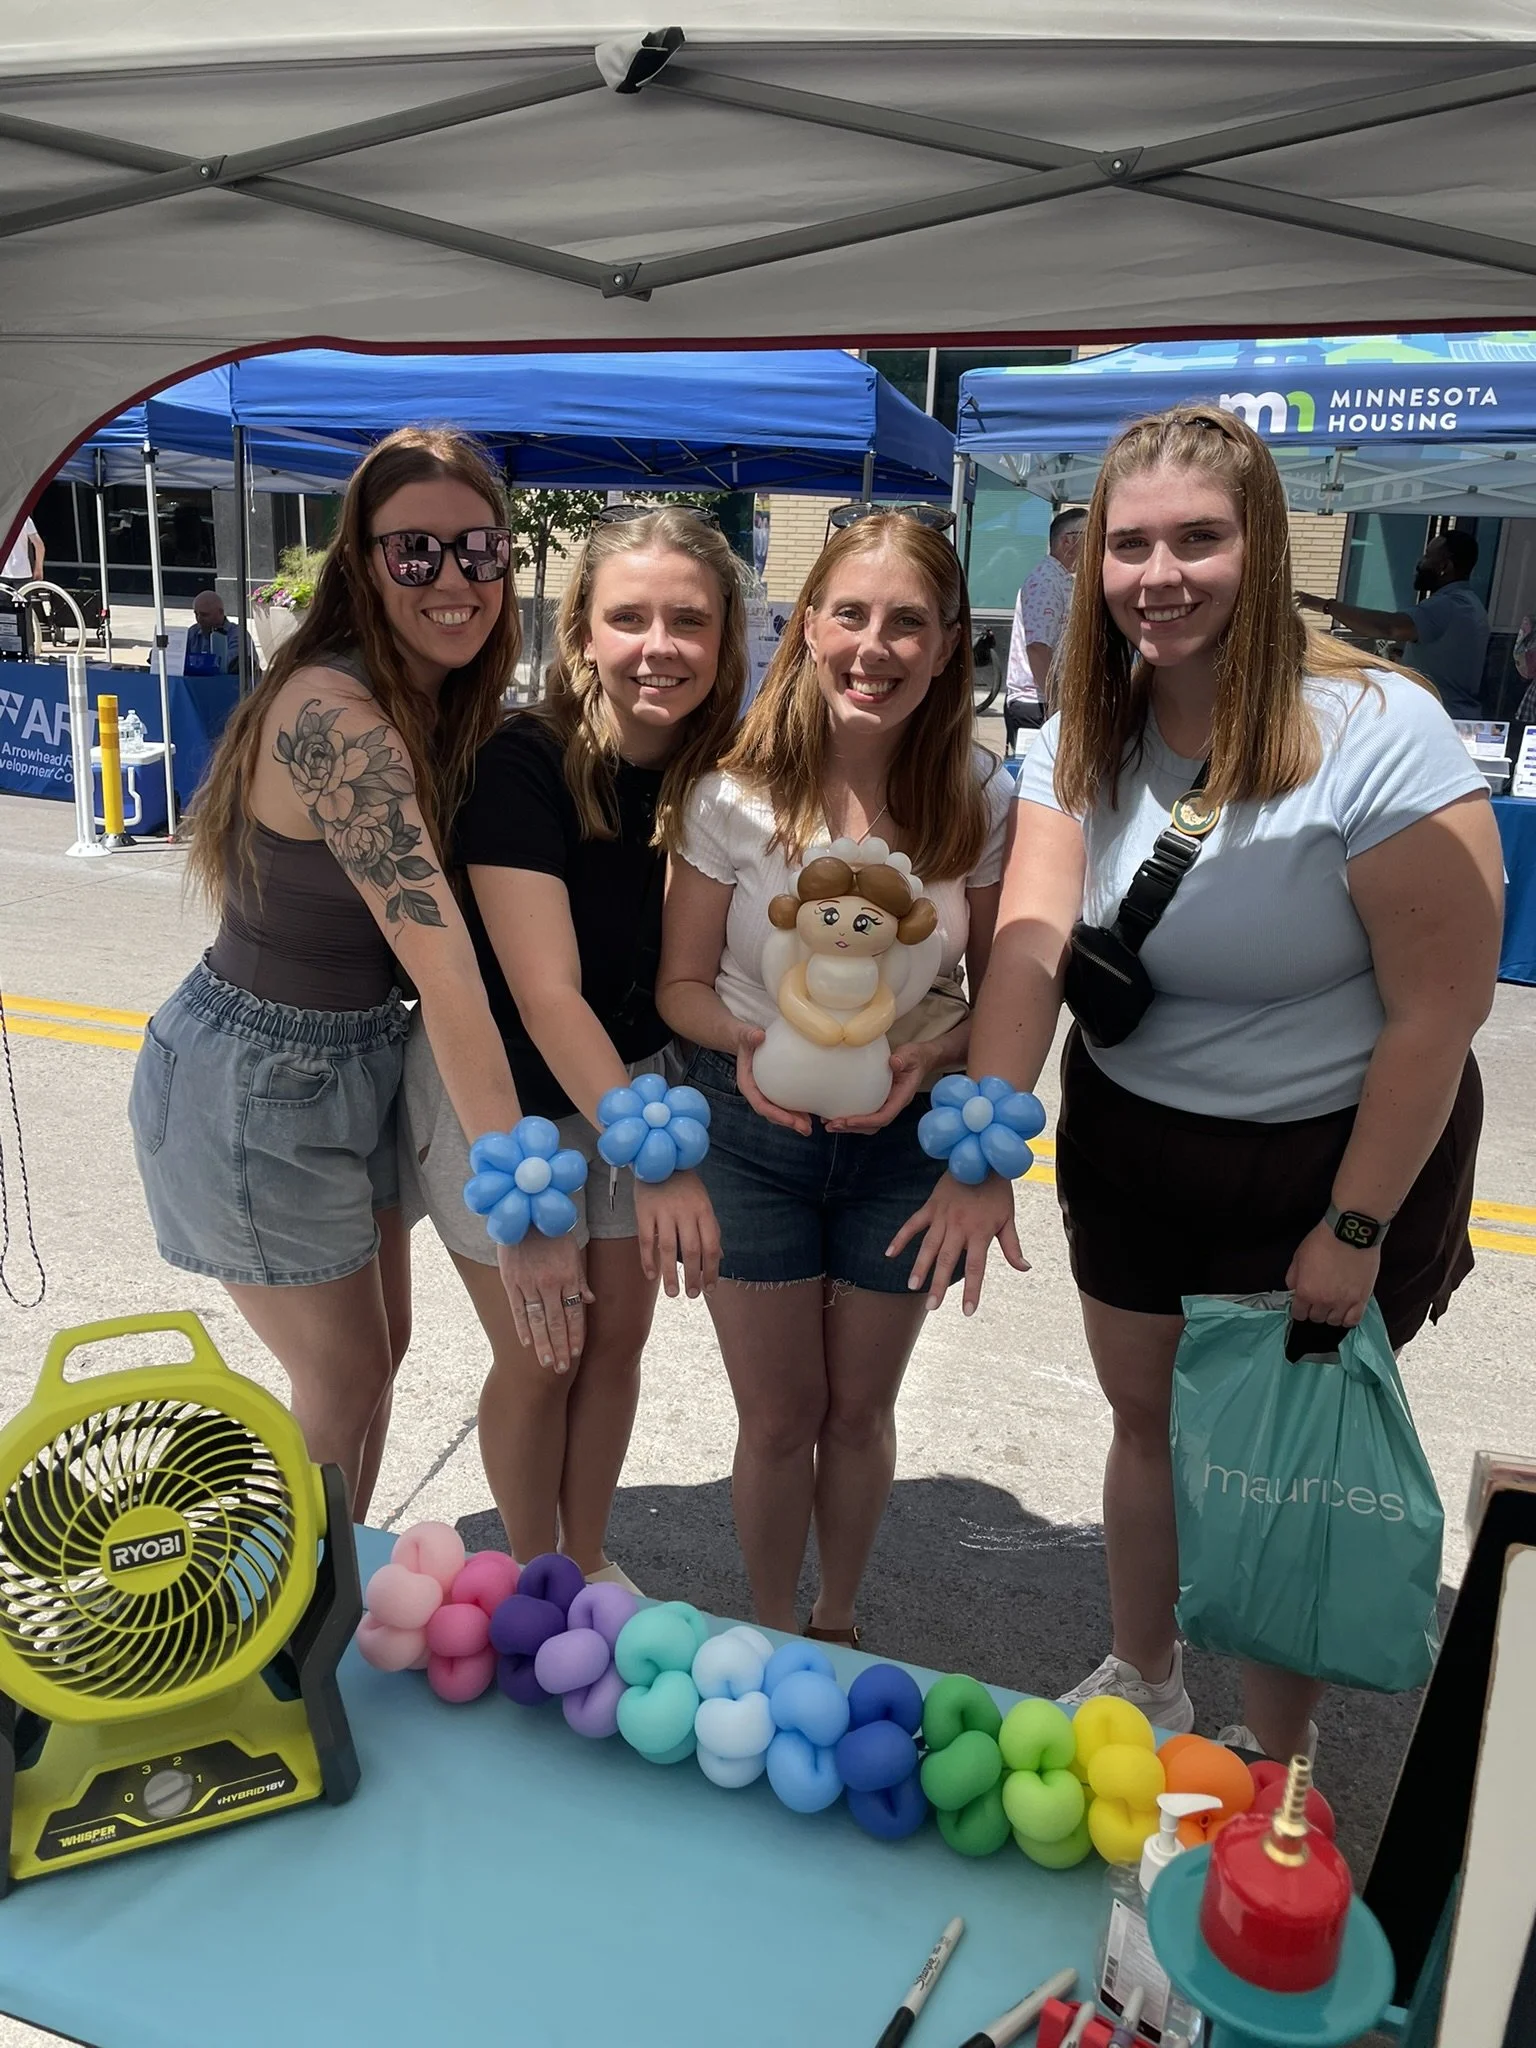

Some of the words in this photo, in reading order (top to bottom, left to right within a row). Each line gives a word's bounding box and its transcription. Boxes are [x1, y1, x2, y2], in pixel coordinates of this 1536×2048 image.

[1329, 387, 1498, 408] MINNESOTA
[1328, 412, 1457, 433] HOUSING
[2, 742, 62, 766] Arrowhead
[1203, 1463, 1405, 1522] maurices
[112, 1534, 181, 1567] RYOBI
[142, 1765, 152, 1775] 3
[172, 1756, 183, 1767] 2
[195, 1774, 203, 1784] 1
[58, 1824, 116, 1848] WHISPER
